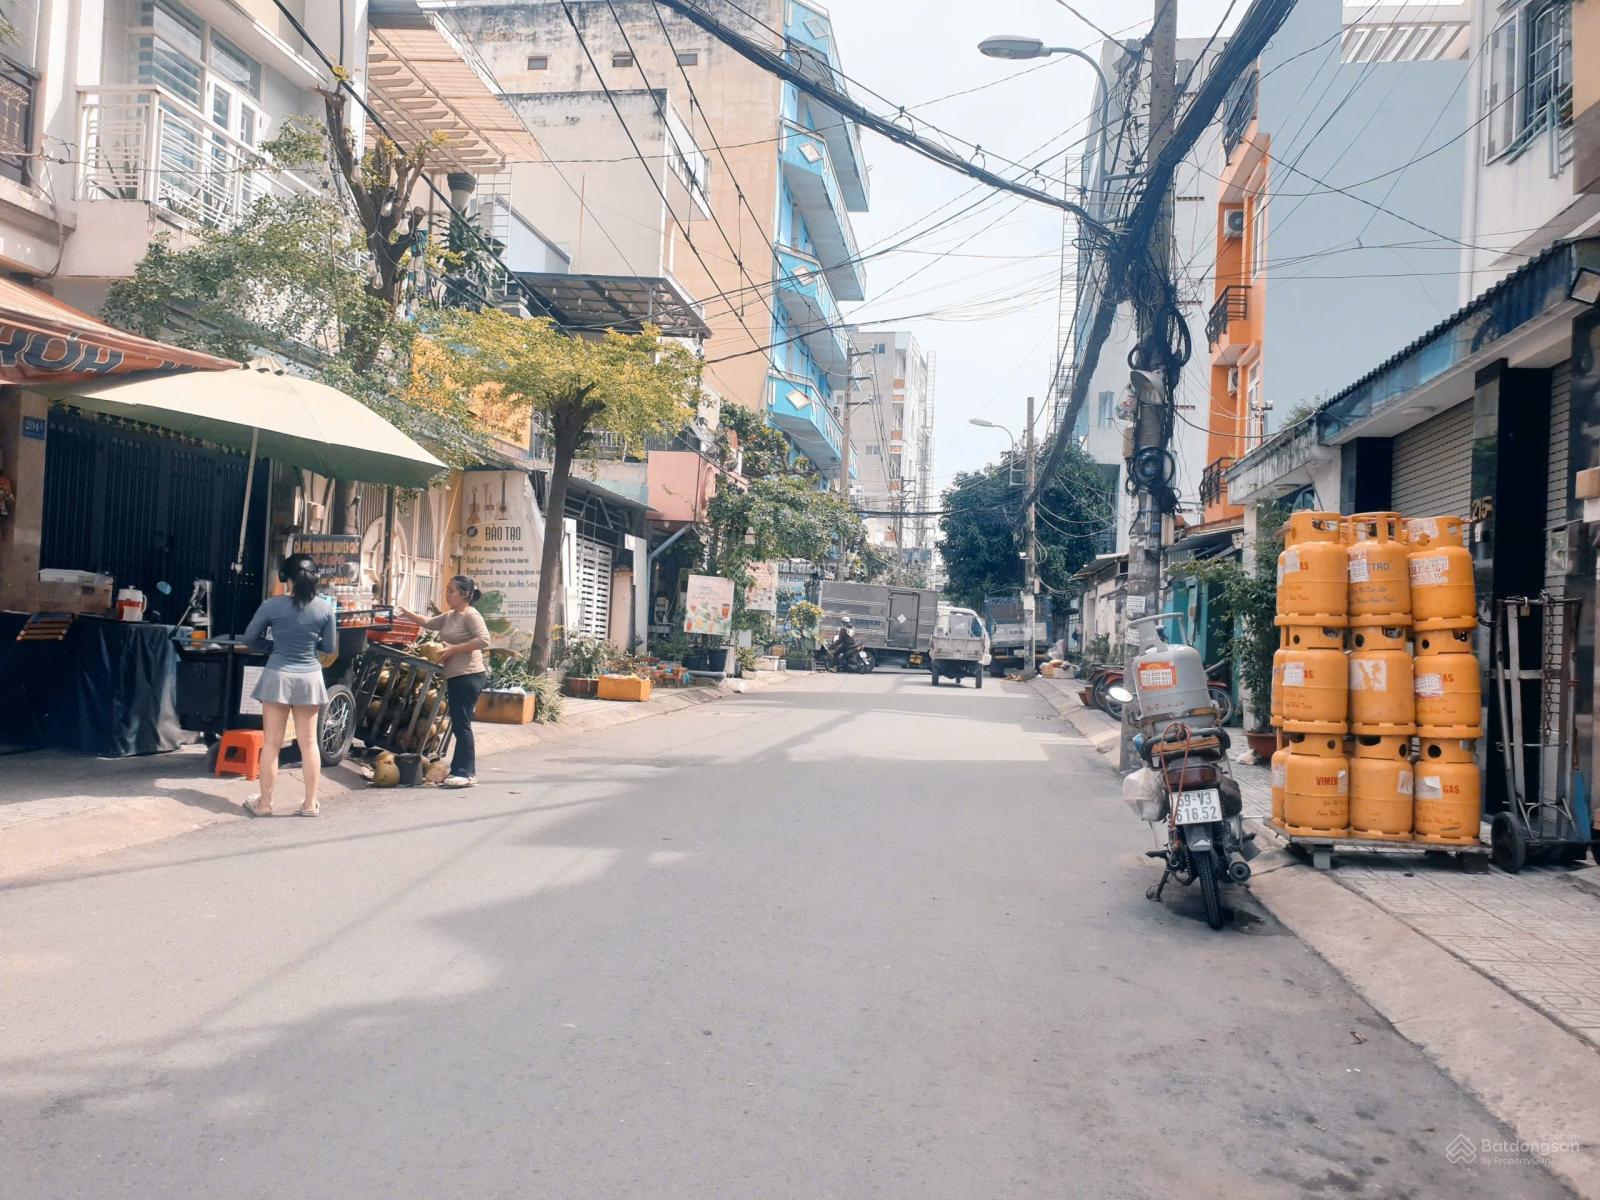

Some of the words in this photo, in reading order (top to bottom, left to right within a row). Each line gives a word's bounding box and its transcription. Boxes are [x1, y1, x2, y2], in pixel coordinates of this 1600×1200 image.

[485, 524, 502, 541] ĐÀO
[505, 526, 521, 543] TẠO
[1443, 785, 1460, 794] GAS
